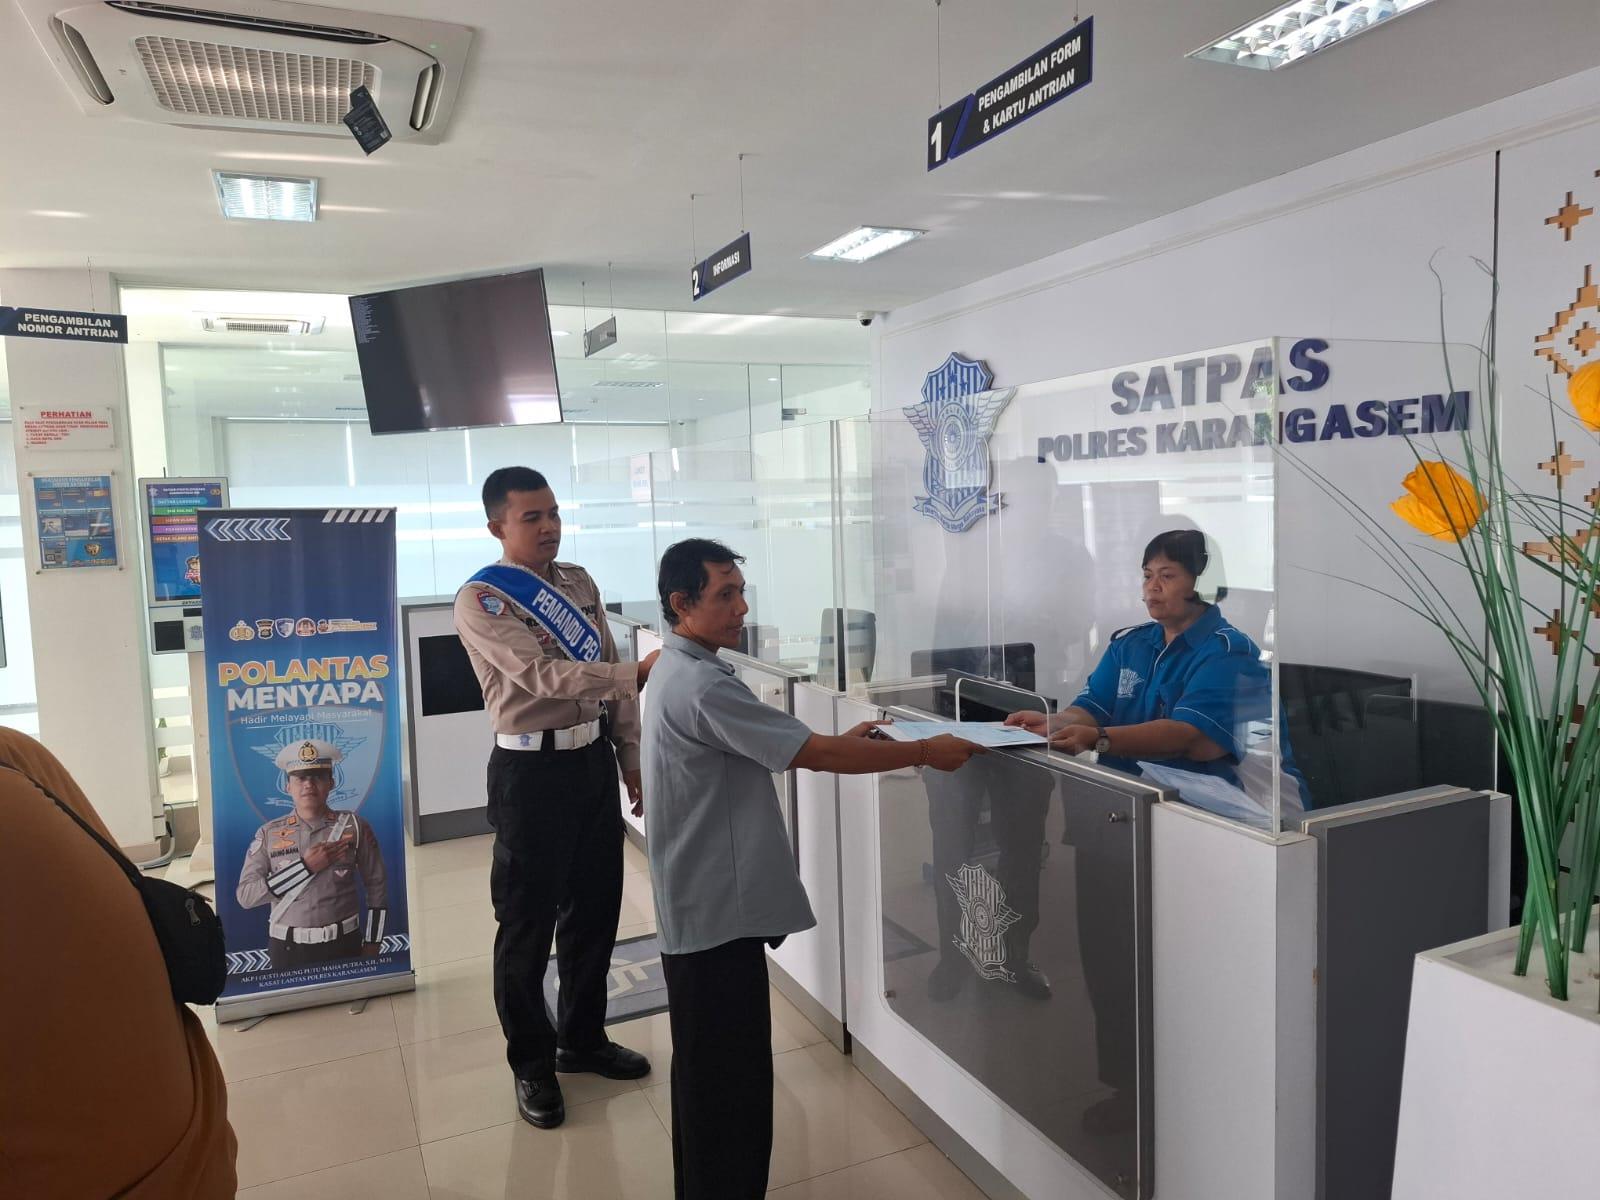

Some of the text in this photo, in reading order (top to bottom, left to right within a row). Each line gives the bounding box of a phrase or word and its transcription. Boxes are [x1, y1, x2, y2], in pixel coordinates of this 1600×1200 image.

[978, 36, 1081, 112] PENGAMBILAN FORM
[983, 69, 1075, 134] & KARTU ANTRIAN
[930, 121, 942, 162] 1
[712, 250, 740, 277] INFORMASI
[692, 270, 700, 296] 2
[18, 323, 119, 338] NOMOR ANTRIAN
[24, 313, 112, 328] PENGAMBILAN
[1111, 338, 1330, 416] SATPAS
[40, 411, 92, 419] PERHATIAN
[1037, 390, 1472, 463] POLRES KARANGASEM
[532, 588, 585, 647] PEMANDU
[218, 654, 390, 687] POLANTAS
[228, 681, 384, 712] MENYAPA
[240, 709, 372, 725] Hadir Melayani Masyarakat
[281, 976, 307, 985] LANTAS
[307, 972, 332, 981] POLRES
